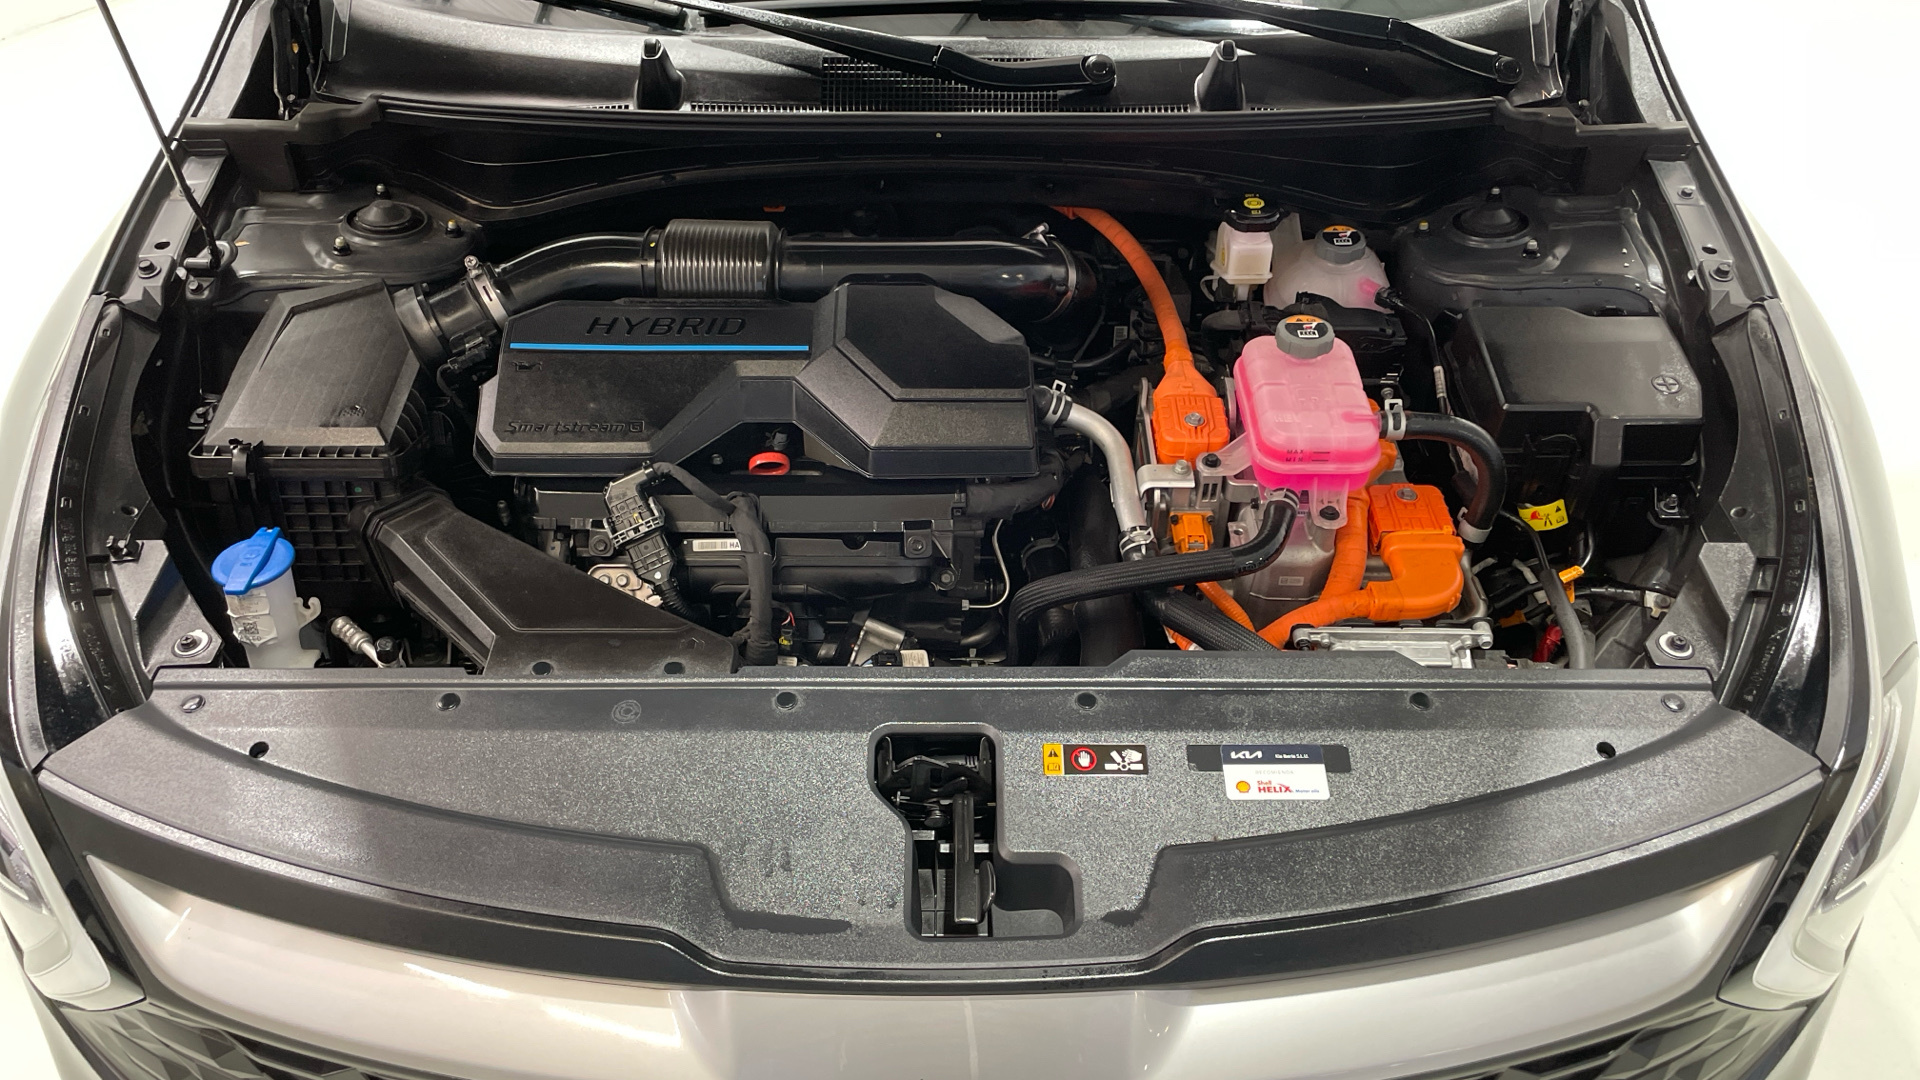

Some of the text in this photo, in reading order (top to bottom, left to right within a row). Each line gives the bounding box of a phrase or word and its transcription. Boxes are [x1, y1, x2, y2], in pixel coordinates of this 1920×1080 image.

[585, 316, 747, 336] HYBRID
[504, 420, 626, 434] Smartstream
[1257, 784, 1292, 793] HELIX
